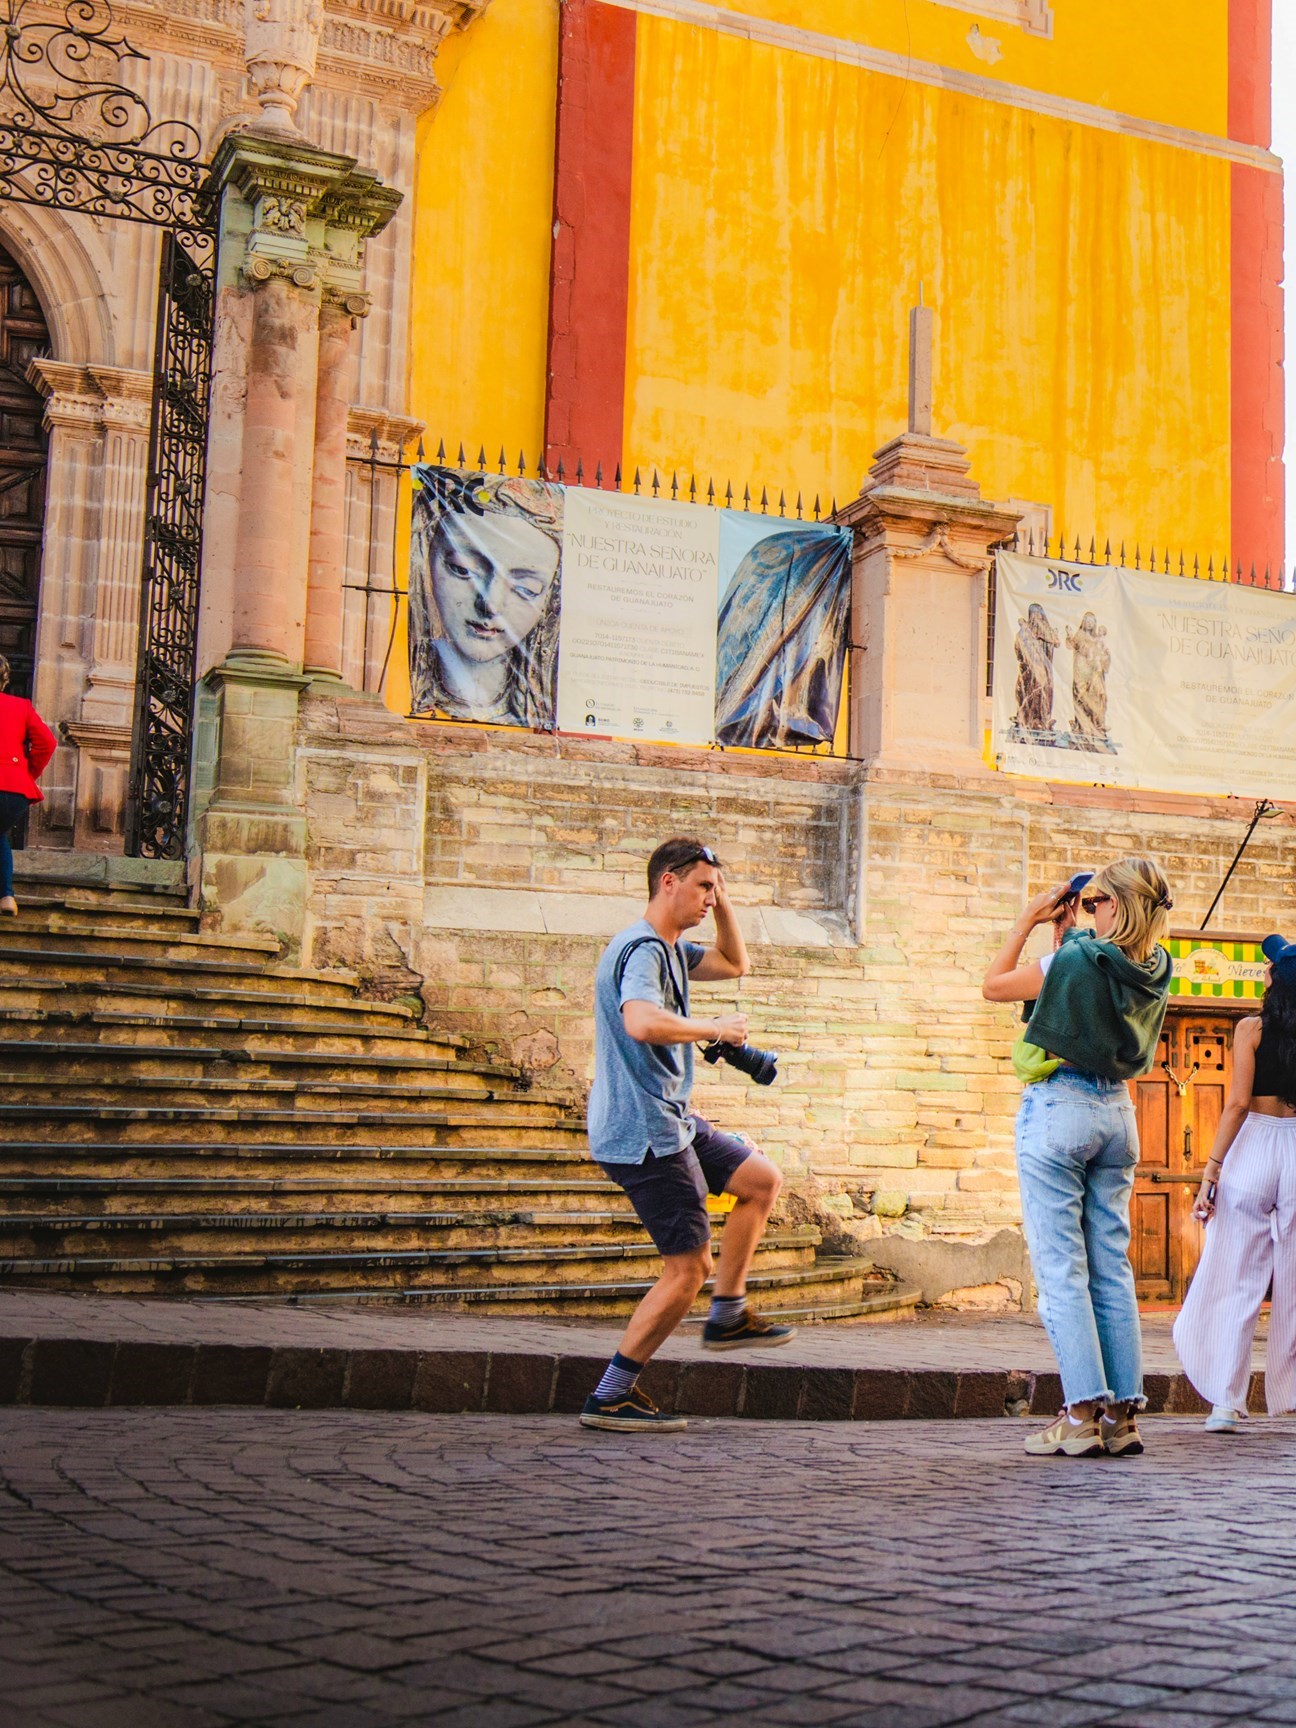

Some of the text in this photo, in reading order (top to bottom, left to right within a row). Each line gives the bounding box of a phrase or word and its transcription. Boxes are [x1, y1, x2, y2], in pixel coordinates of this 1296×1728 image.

[588, 506, 698, 529] PROYECTO DE ESTUDIO
[604, 521, 610, 529] Y
[577, 552, 599, 570] DE
[650, 544, 716, 566] SEÑORA
[587, 583, 644, 597] RESTAUREMOS
[623, 597, 674, 609] GUANAJUATO
[1170, 636, 1192, 656] DE
[1180, 680, 1243, 694] RESTAUREMOS
[1206, 694, 1272, 709] DE GUANAJUATO
